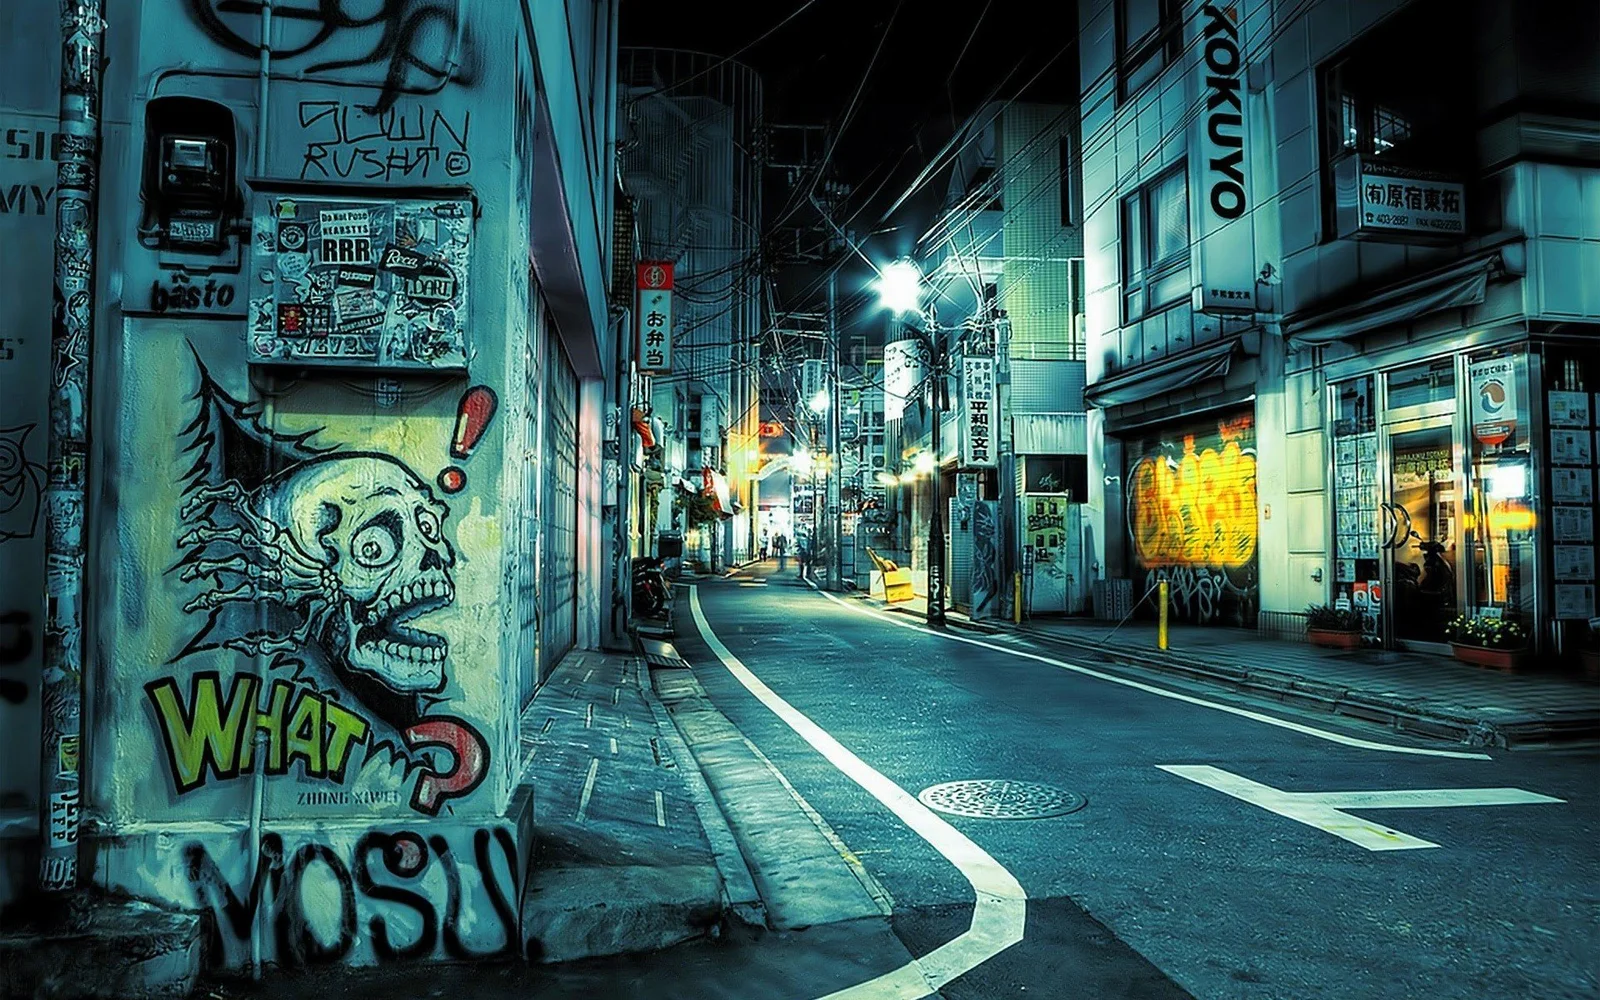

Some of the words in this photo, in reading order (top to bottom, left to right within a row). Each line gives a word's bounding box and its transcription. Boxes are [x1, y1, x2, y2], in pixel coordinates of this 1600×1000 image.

[1204, 5, 1246, 220] KOKUYO
[322, 238, 370, 263] RRR
[646, 310, 667, 367] お弁当
[970, 401, 989, 462] 平和堂文具
[144, 671, 367, 795] WHAT
